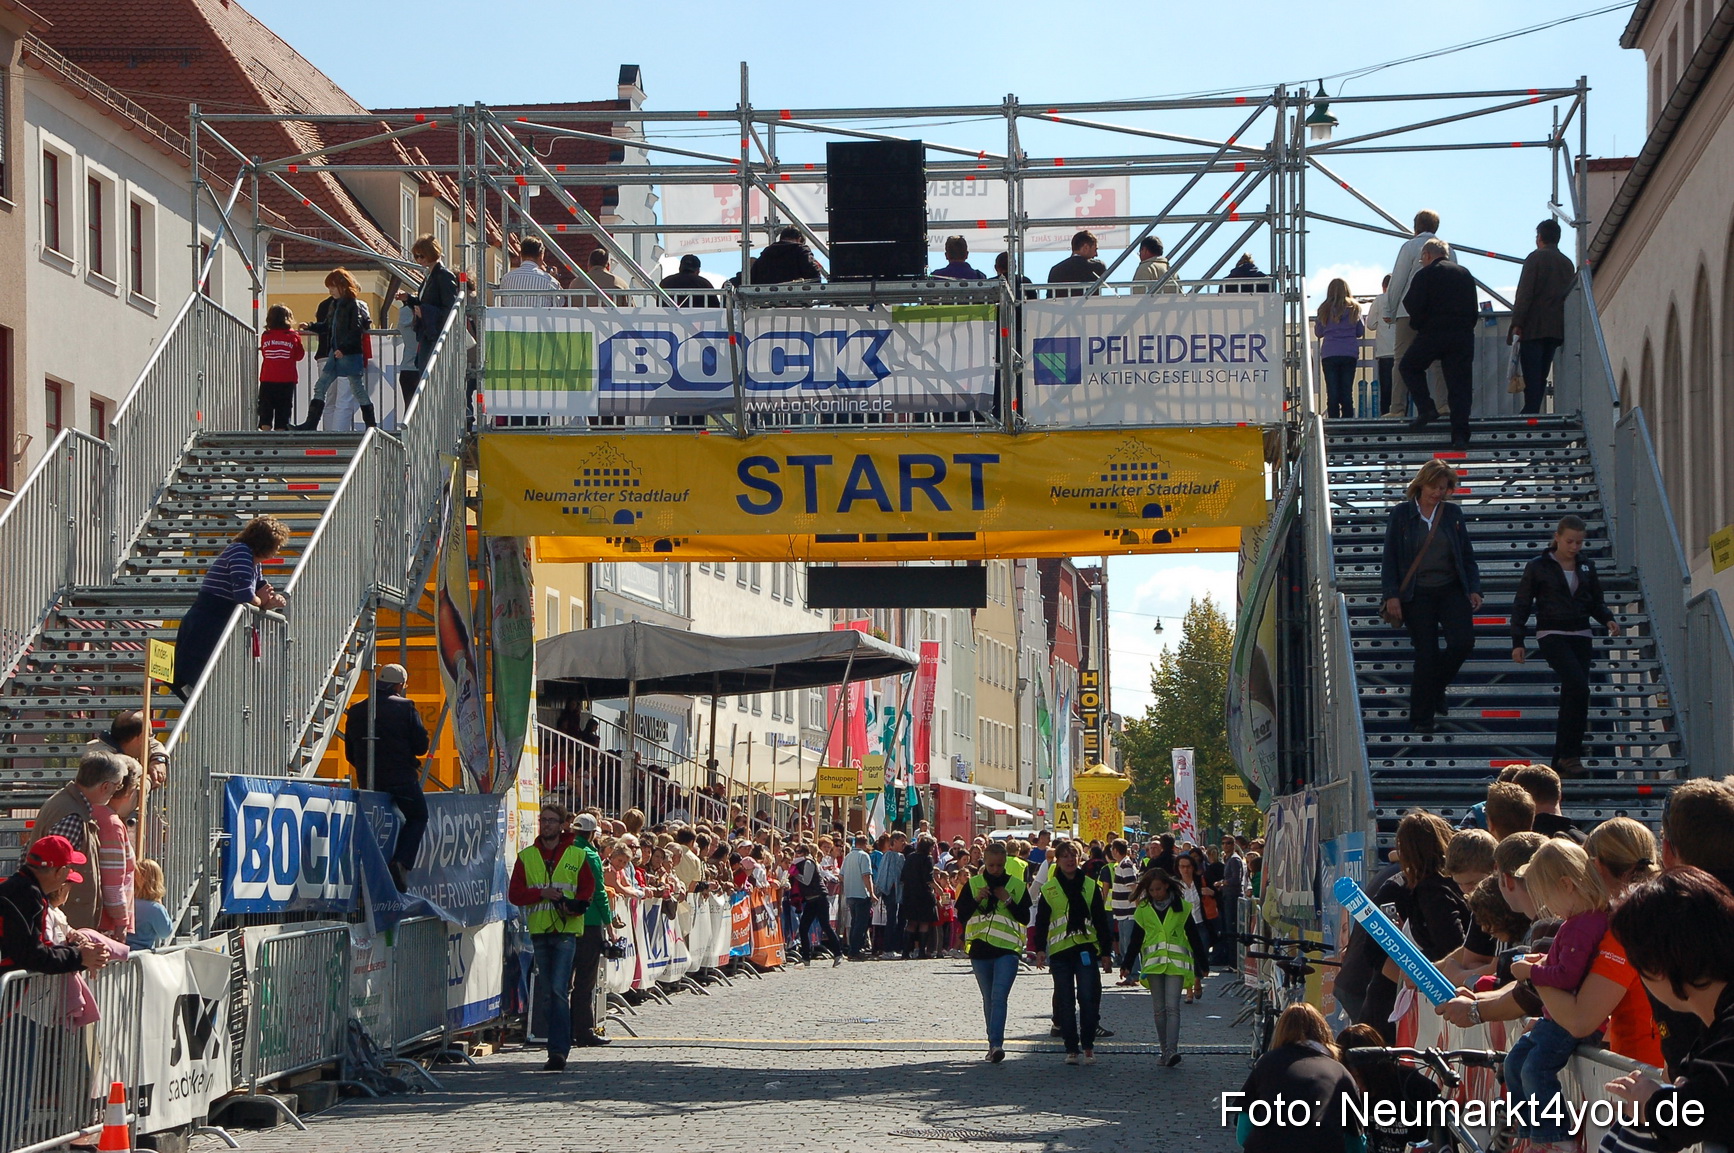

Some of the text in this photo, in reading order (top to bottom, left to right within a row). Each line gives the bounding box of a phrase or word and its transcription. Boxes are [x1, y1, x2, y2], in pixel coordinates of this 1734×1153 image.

[1088, 333, 1269, 366] PFLEIDERER
[599, 329, 894, 391] BOCK
[1087, 369, 1269, 386] AKTIENGESELLSCHAFT
[744, 397, 893, 413] www.bockonline.de
[736, 452, 1000, 515] START
[1049, 480, 1221, 499] Neumarkter Stadtlauf
[523, 488, 690, 504] Neumarkter Stadtlauf
[1080, 671, 1099, 767] HOTE
[862, 764, 884, 773] Jugend-
[868, 771, 879, 779] lauf
[819, 774, 856, 784] Schnupper-
[831, 781, 843, 789] lauf
[1058, 810, 1069, 825] A
[233, 791, 357, 901] BOCK
[1369, 919, 1448, 1004] www.maxi-dsl.de
